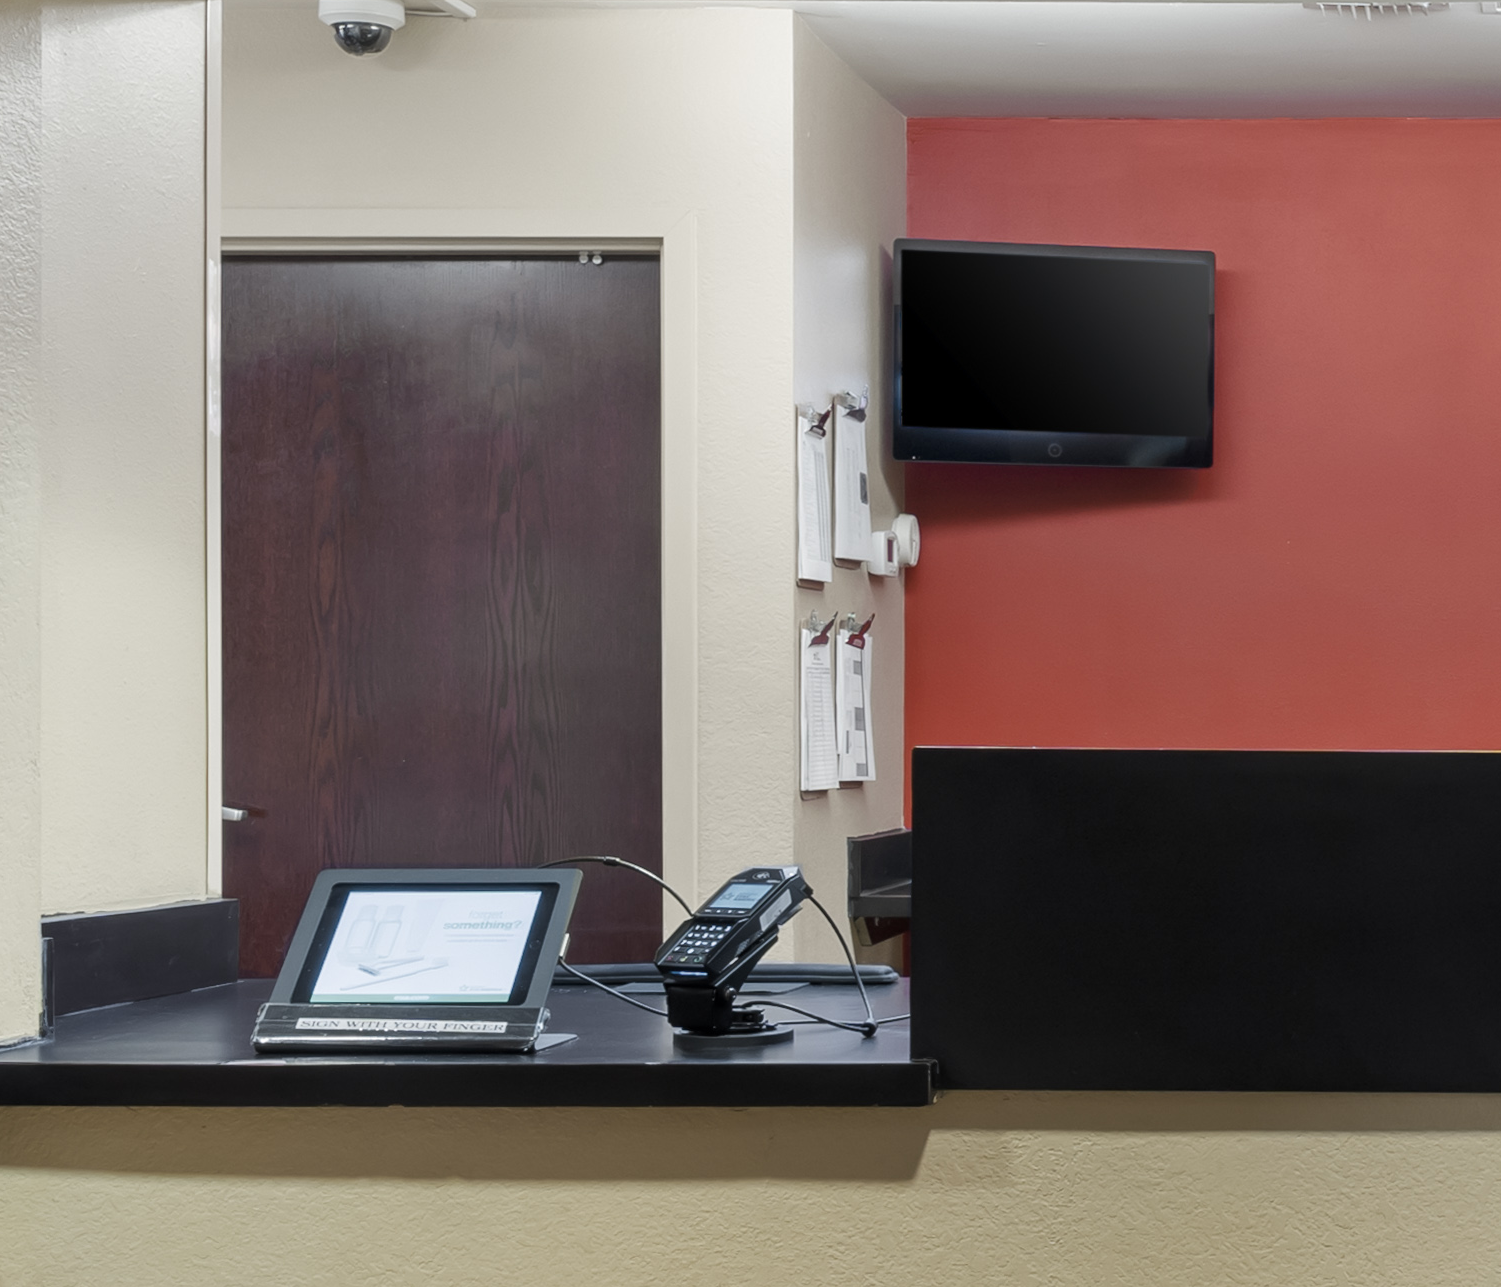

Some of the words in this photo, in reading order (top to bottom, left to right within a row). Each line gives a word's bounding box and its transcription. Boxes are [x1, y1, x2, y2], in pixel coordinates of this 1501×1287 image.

[443, 920, 523, 931] something?
[300, 1020, 341, 1028] SIGN
[347, 1021, 387, 1029] WITH
[393, 1022, 438, 1030] YOUR
[443, 1023, 505, 1032] FINGER
